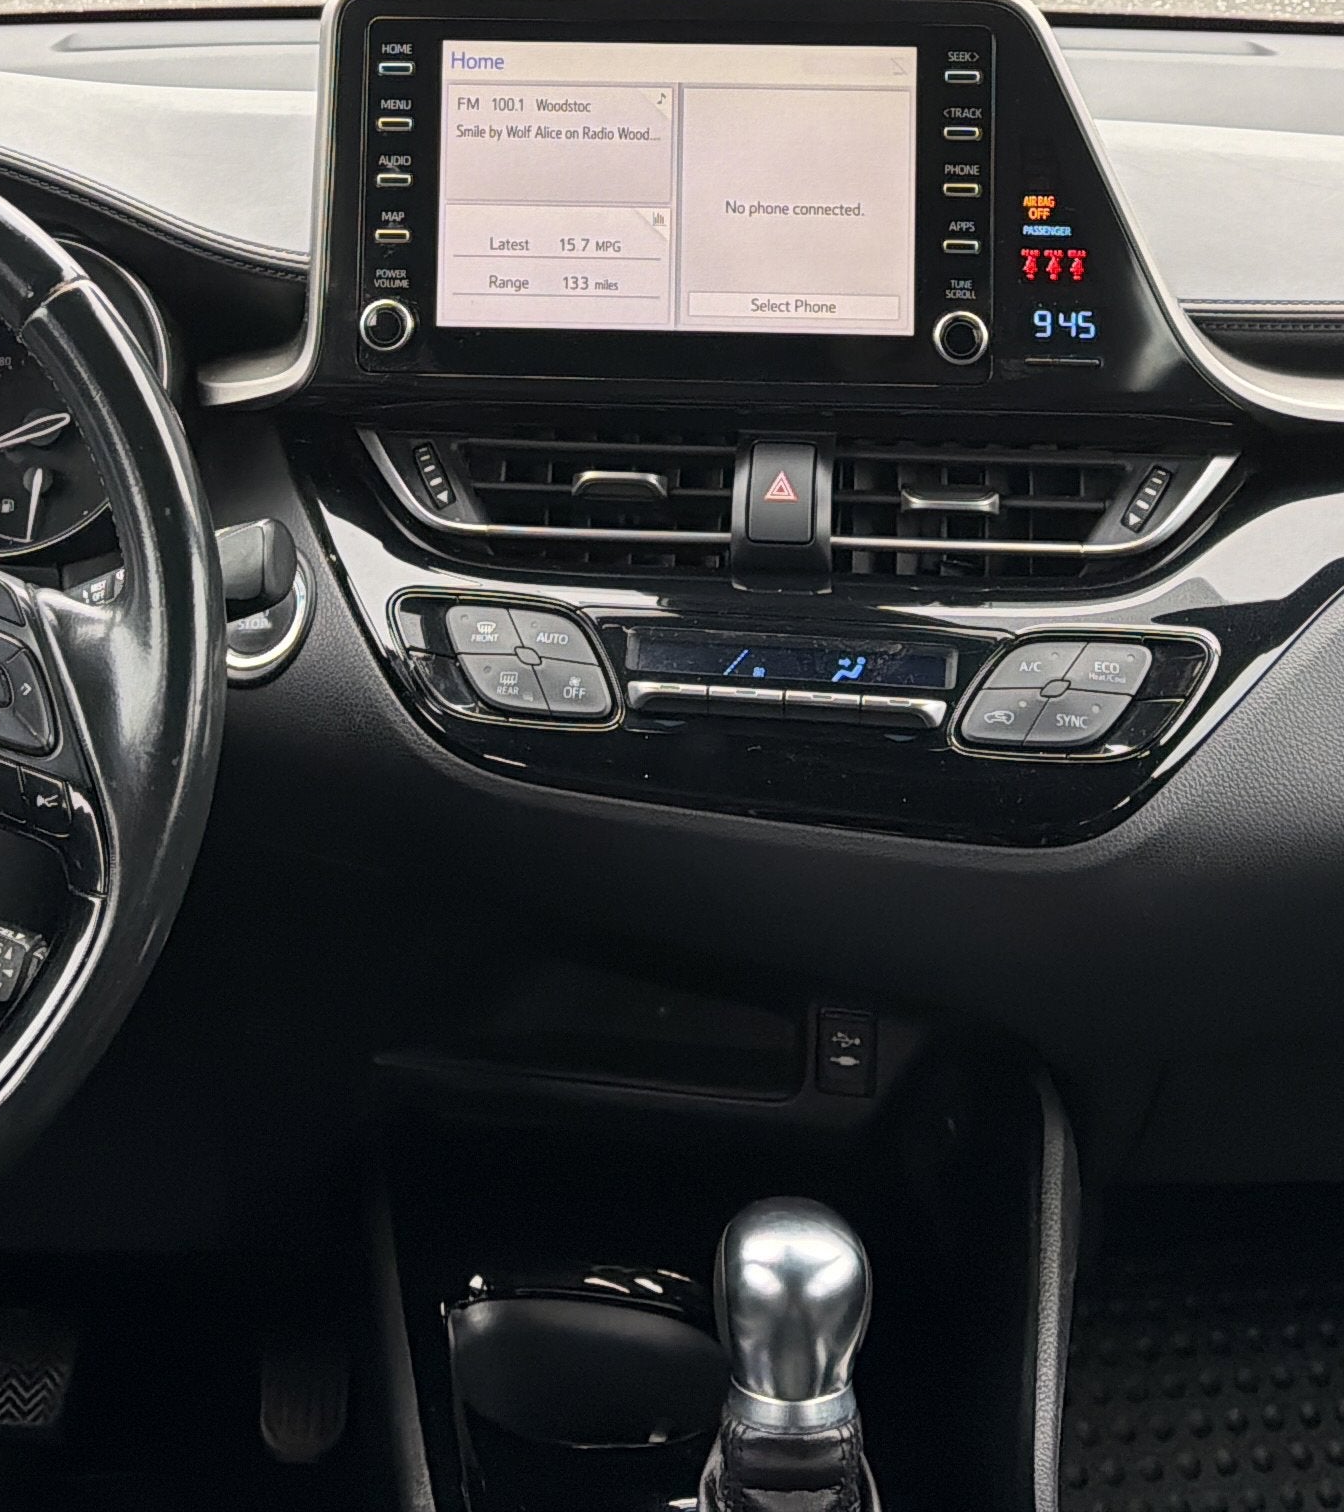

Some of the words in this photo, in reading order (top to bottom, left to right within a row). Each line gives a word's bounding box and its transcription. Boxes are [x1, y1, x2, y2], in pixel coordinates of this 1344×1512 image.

[381, 44, 413, 55] HOME
[451, 52, 505, 71] Home
[380, 100, 412, 110] MENU
[457, 98, 480, 111] FM
[491, 98, 524, 112] 100.1
[535, 98, 592, 114] Woodstoc
[456, 125, 486, 140] Smile
[489, 125, 503, 143] by
[506, 125, 532, 140] Wolf
[535, 126, 563, 140] Alice
[564, 129, 580, 141] on
[582, 126, 615, 141] Radio
[378, 155, 412, 167] AUDIO
[944, 164, 981, 176] PHONE
[725, 200, 746, 215] No
[749, 200, 790, 220] phone
[792, 201, 865, 217] connected.
[1028, 208, 1051, 220] OFF
[381, 211, 405, 222] MAP
[949, 222, 976, 233] APPS
[1022, 225, 1072, 236] PASSENGER
[489, 237, 530, 252] Latest
[595, 240, 622, 253] MPG
[376, 269, 407, 279] POWER
[374, 279, 410, 289] VOLUME
[489, 276, 529, 293] Range
[562, 276, 589, 291] 133
[594, 278, 619, 291] miles
[950, 280, 973, 290] TUNE
[946, 290, 977, 300] SCROLL
[750, 299, 790, 314] Select
[794, 300, 836, 315] Phone
[471, 633, 499, 643] FRONT
[536, 632, 569, 646] AUTO
[1019, 661, 1042, 674] A/C
[1094, 661, 1120, 675] ECO
[496, 686, 519, 696] REAR
[563, 686, 586, 700] OFF
[1055, 714, 1089, 730] SYNC
